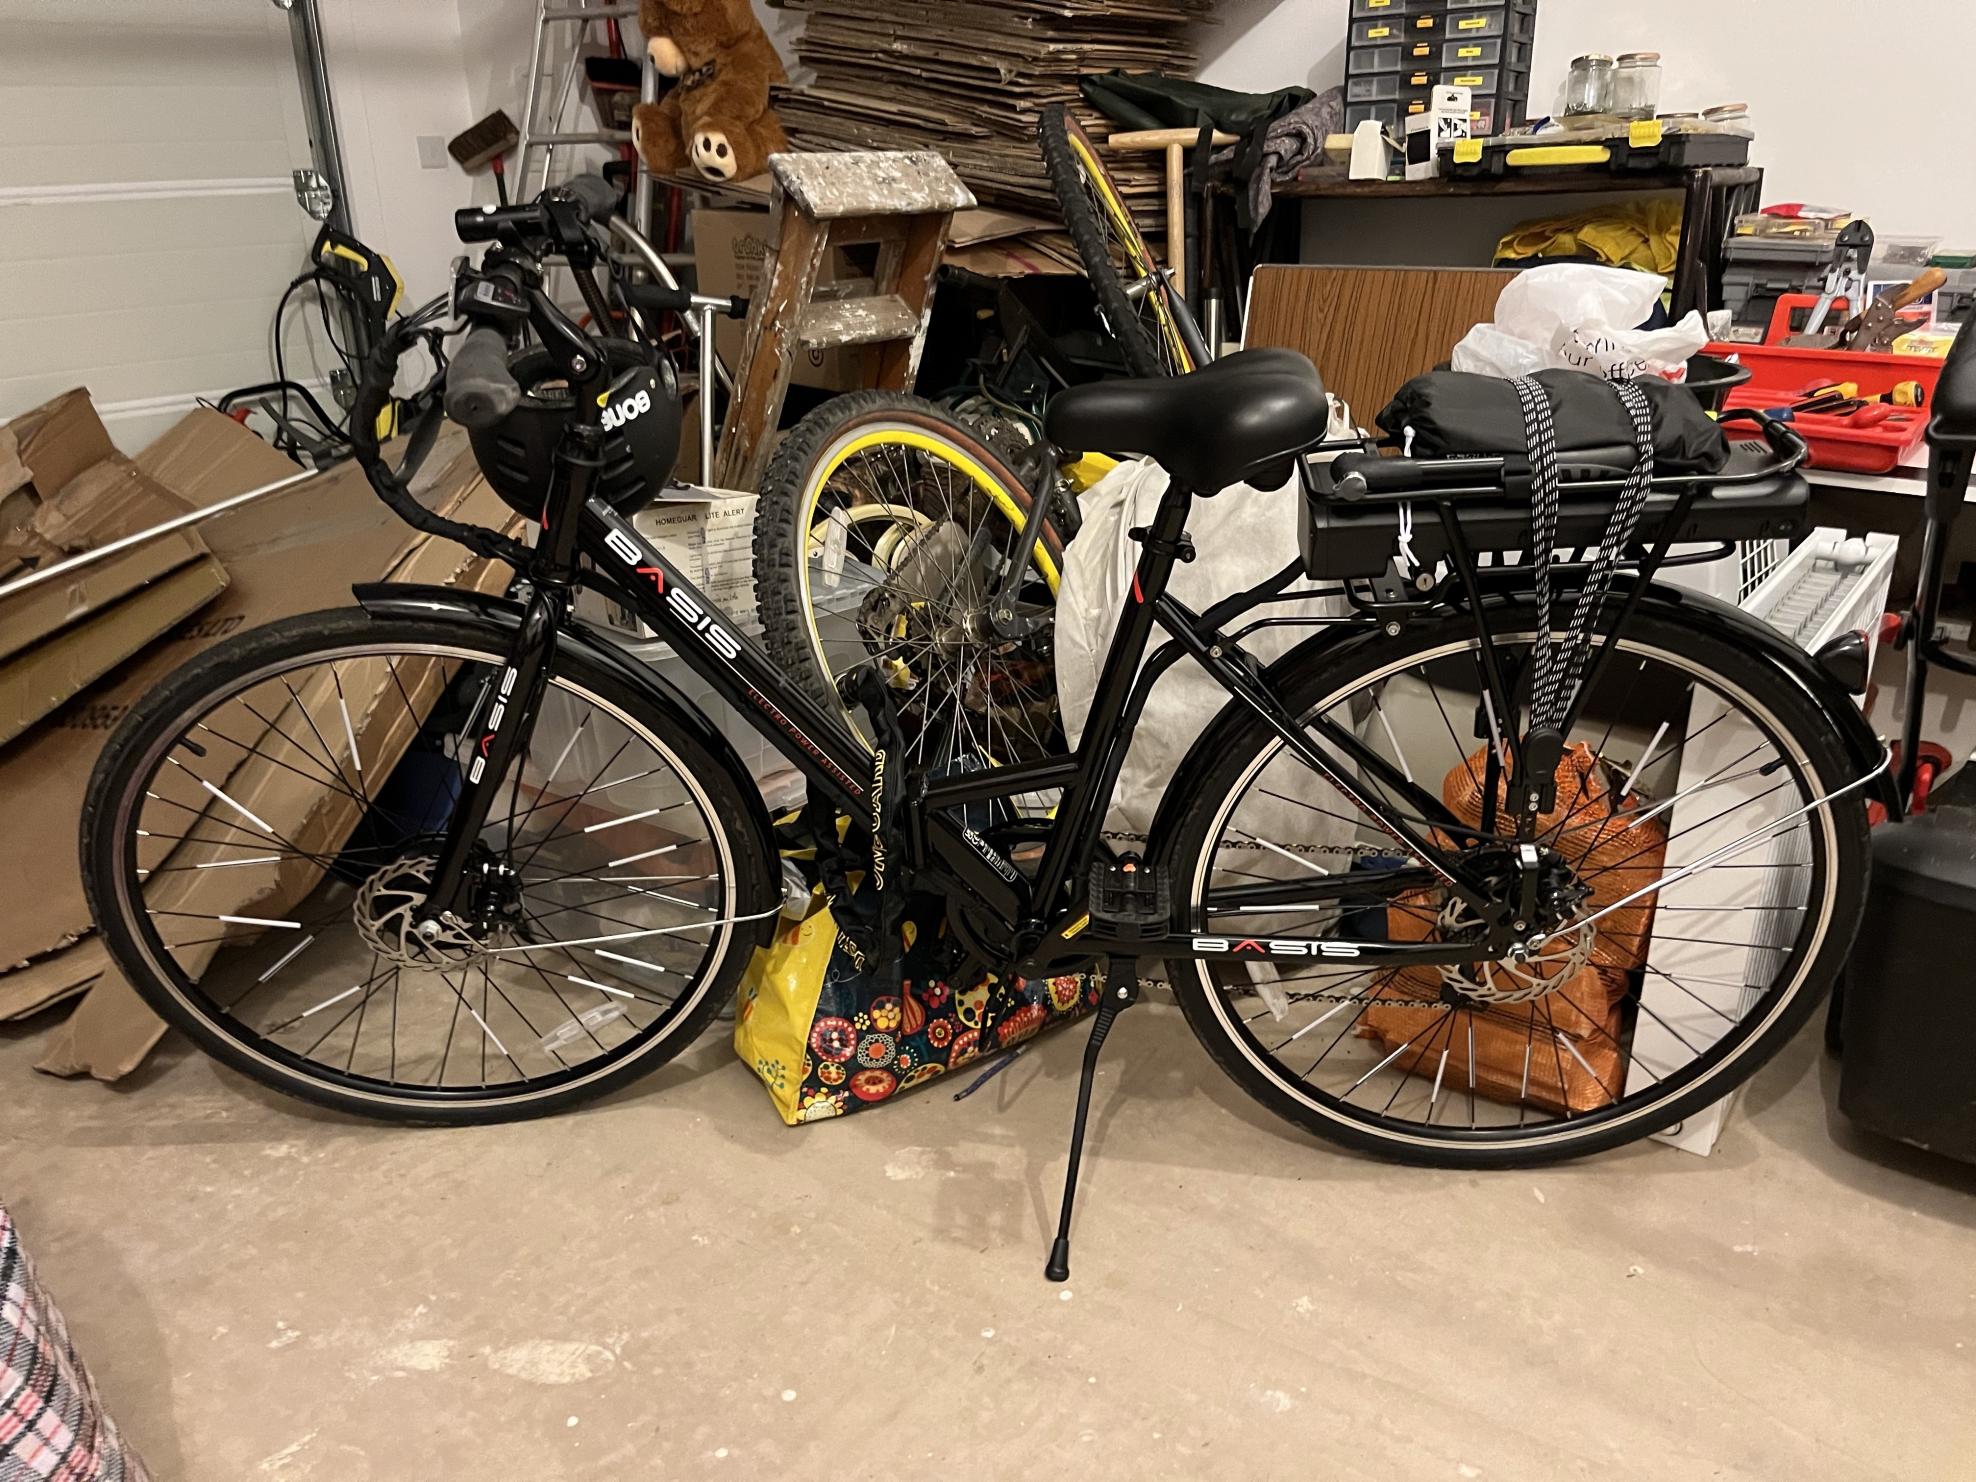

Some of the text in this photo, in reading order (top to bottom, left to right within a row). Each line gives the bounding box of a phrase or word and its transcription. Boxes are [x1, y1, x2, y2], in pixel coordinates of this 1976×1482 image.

[704, 511, 720, 520] LITE
[723, 508, 745, 518] ALERT
[604, 528, 742, 660] BASIS
[469, 665, 518, 784] BASIS
[747, 687, 861, 796] ELECTRO POWER ASSISTED
[1192, 938, 1361, 958] BASIS
